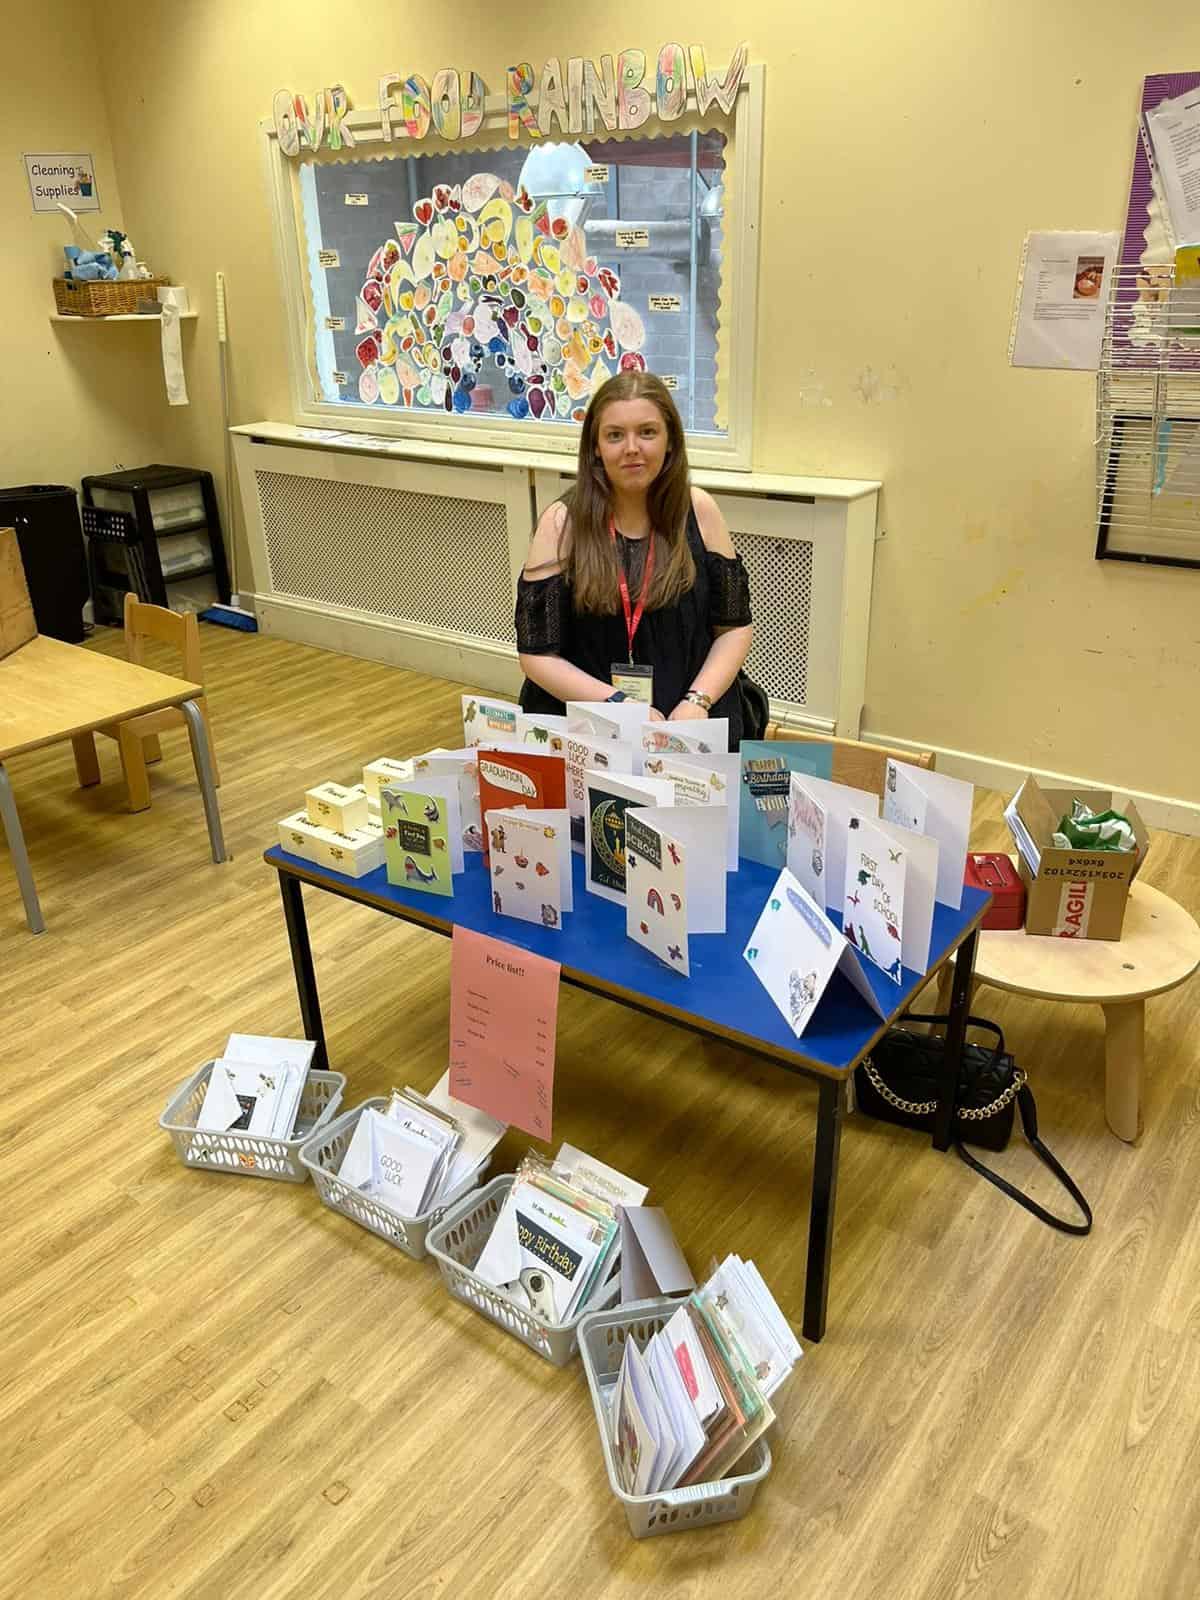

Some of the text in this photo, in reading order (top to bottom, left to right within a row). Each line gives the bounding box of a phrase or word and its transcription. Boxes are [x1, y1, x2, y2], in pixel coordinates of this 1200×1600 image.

[273, 41, 748, 157] OUR FOOD RAINBOW
[31, 164, 75, 178] Cleaning
[35, 185, 79, 199] Supplies
[567, 740, 589, 757] GOOD
[480, 761, 524, 785] GRADUATION
[750, 773, 790, 784] Birthday
[521, 785, 536, 796] DAY
[860, 853, 878, 873] FIRST
[871, 874, 885, 892] DAY
[873, 898, 899, 927] SCHOOL
[486, 955, 506, 971] Price
[381, 1155, 402, 1172] GOOD
[384, 1169, 403, 1184] LUCK
[534, 1235, 577, 1274] Birthday
